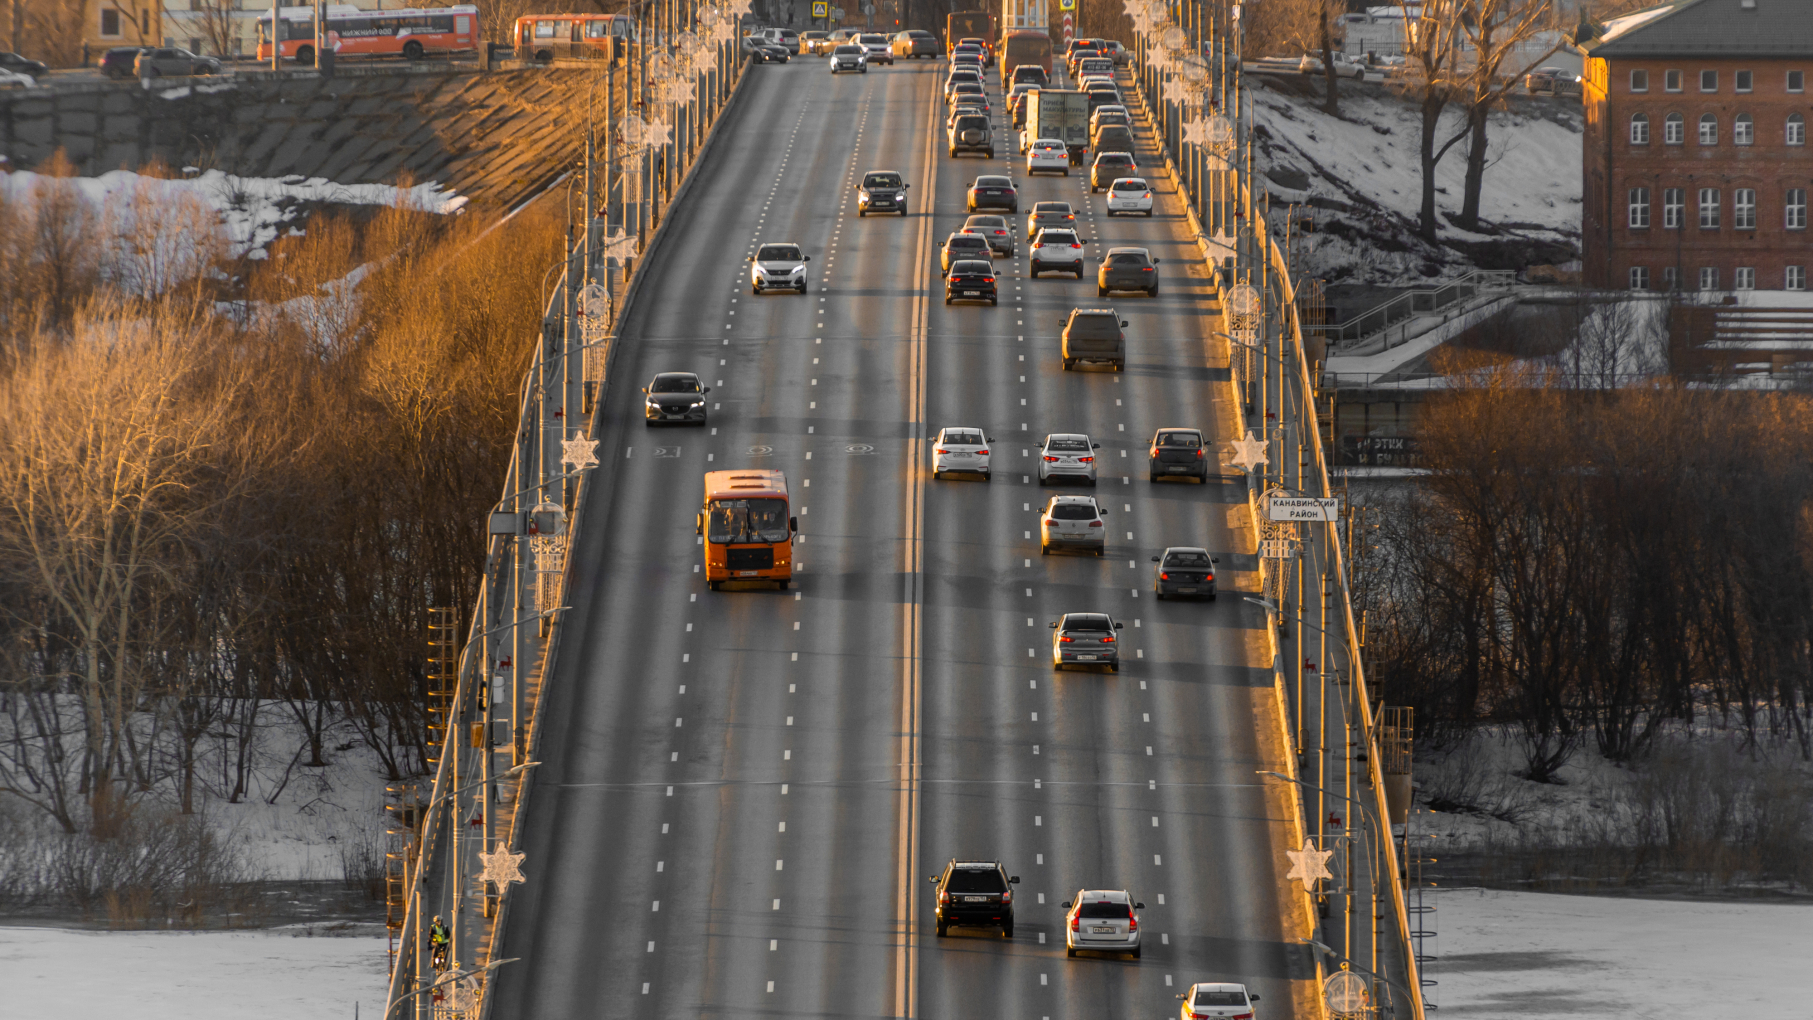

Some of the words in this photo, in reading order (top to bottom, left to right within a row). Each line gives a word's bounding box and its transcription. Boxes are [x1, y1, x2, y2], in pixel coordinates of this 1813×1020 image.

[341, 27, 378, 37] НИЖНИЙ
[1273, 498, 1336, 508] КАНАВИНСКИЙ
[1289, 509, 1319, 518] РАЙОН
